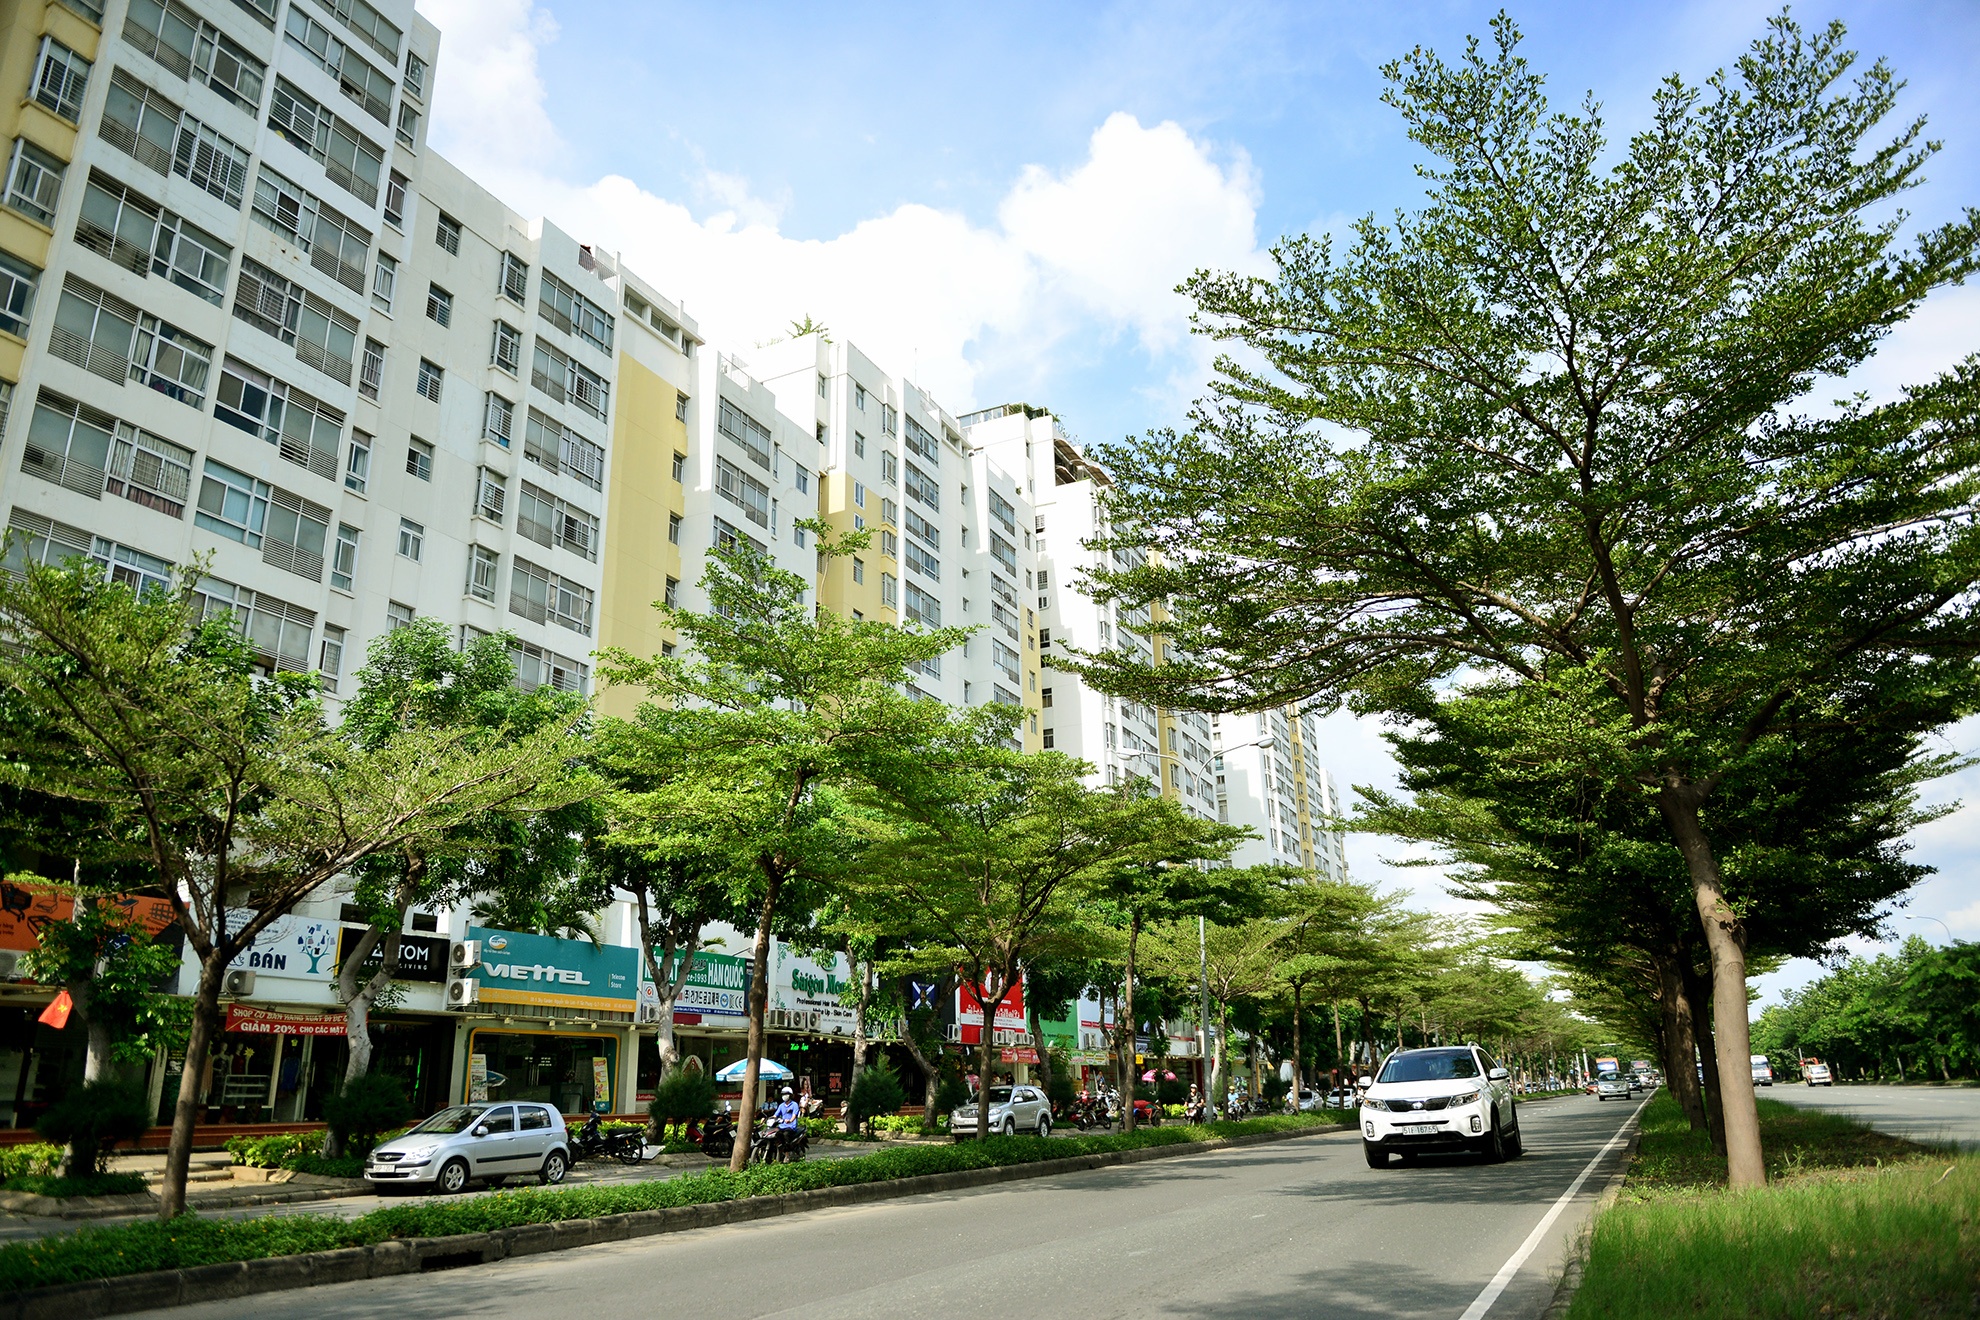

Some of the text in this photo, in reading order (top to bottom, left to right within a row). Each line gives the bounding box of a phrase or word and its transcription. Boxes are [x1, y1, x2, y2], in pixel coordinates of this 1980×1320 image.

[249, 947, 287, 970] BÁN
[483, 962, 590, 985] VIETTEL
[708, 958, 744, 988] HÀN QUỐC
[233, 1008, 253, 1017] SHOP
[241, 1020, 270, 1032] GIẢM
[273, 1024, 296, 1034] 20%
[299, 1026, 314, 1034] CHO
